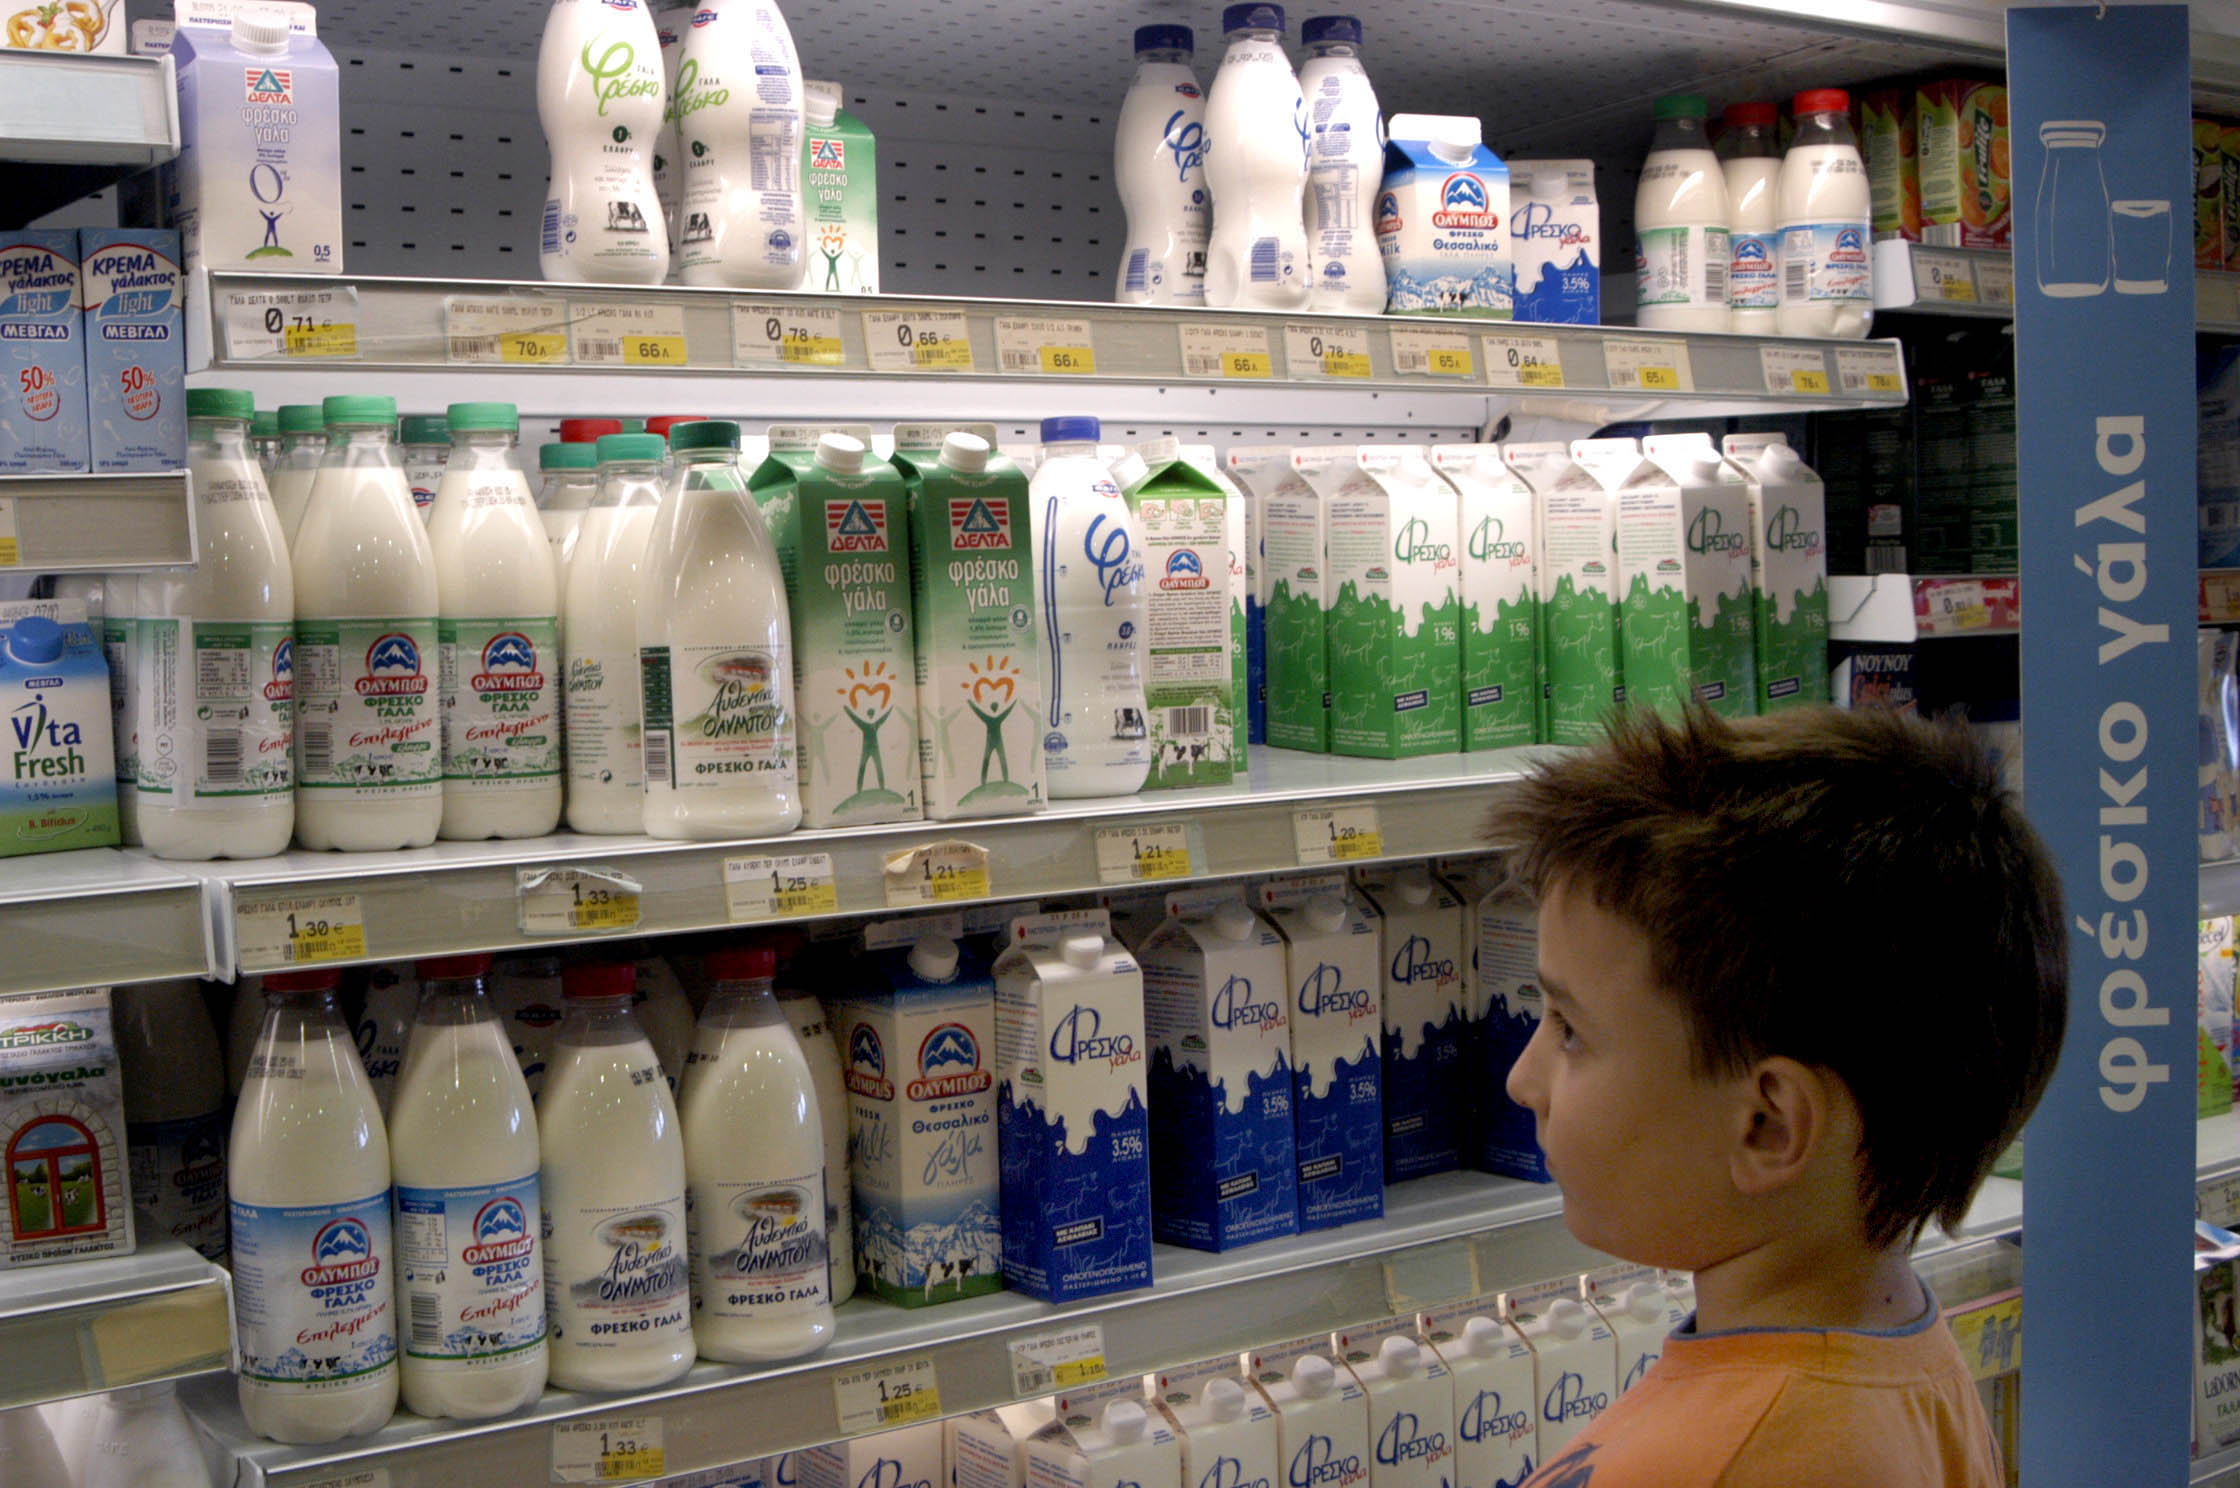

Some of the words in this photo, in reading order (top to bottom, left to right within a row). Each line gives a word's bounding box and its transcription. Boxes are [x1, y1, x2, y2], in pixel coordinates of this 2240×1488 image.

[248, 93, 291, 104] ΔΕΛΤΑ
[242, 106, 297, 128] φρέσκο
[255, 126, 289, 144] γάλα
[812, 157, 843, 169] ΔΕΛΤΑ
[1434, 212, 1497, 228] ΟΛΥΜΠΟΣ
[1433, 236, 1499, 252] Θεσσαλικό
[1449, 230, 1483, 238] ΦΡΕΣΚΟ
[93, 252, 155, 277] ΚΡΕΜΑ
[9, 271, 74, 294] γάλακτος
[112, 271, 174, 294] γάλακτος
[16, 294, 52, 314] light
[118, 294, 153, 314] light
[5, 327, 66, 338] ΜΕΒΓΑΛ
[107, 327, 165, 339] ΜΕΒΓΑΛ
[20, 366, 55, 392] 50%
[121, 366, 155, 393] 50%
[831, 534, 886, 551] ΔΕΛΤΑ
[954, 533, 1010, 548] ΔΕΛΤΑ
[2073, 415, 2170, 665] γάλα
[824, 558, 894, 589] φρέσκο
[948, 556, 1018, 585] φρέσκο
[1161, 579, 1208, 588] ΟΛΥΜΠΟΣ
[843, 587, 886, 618] γάλα
[966, 584, 1009, 614] γάλα
[358, 678, 425, 693] ΟΛΥΜΠΟΣ
[474, 676, 542, 689] ΟΛΥΜΠΟΣ
[364, 696, 423, 707] ΦΡΕΣΚΟ
[480, 692, 539, 702] ΦΡΕΣΚΟ
[492, 702, 530, 712] ΓΑΛΑ
[377, 707, 415, 717] ΓΑΛΑ
[11, 694, 82, 754] Vita
[15, 748, 84, 779] Fresh
[695, 761, 753, 775] ΦΡΕΣΚΟ
[908, 790, 914, 806] 1
[1032, 782, 1039, 798] 1
[771, 870, 807, 893] 1,25
[571, 883, 609, 907] 1,33
[2076, 701, 2170, 1112] φρέσκο
[287, 913, 329, 940] 1,30
[1298, 961, 1369, 1017] ΦΡΕΣΚΟ
[1212, 974, 1279, 1031] ΦΡΕΣΚΟ
[0, 1029, 87, 1048] ΤΡΙΚΚΗ
[1050, 1004, 1133, 1065] ΦΡΕΣΚΟ
[1108, 1045, 1142, 1075] γάλα
[910, 1073, 988, 1100] ΟΛΥΜΠΟΣ
[929, 1099, 975, 1113] ΦΡΕΣΚΟ
[912, 1112, 990, 1134] Θεσσαλικό
[1112, 1137, 1143, 1157] 3.5%
[466, 1239, 533, 1263] ΟΛΥΜΠΟΣ
[736, 1241, 812, 1273] ΟΛΥΜΠΟΥ
[304, 1261, 377, 1283] ΟΛΥΜΠΟΣ
[472, 1257, 530, 1277] ΦΡΕΣΚΟ
[311, 1280, 375, 1298] ΦΡΕΣΚΟ
[485, 1272, 523, 1286] ΓΑΛΑ
[600, 1265, 676, 1301] ΟΛΥΜΠΟΥ
[325, 1293, 366, 1309] ΓΑΛΑ
[728, 1292, 785, 1306] ΦΡΕΣΚΟ
[790, 1286, 819, 1301] ΓΑΛΑ
[591, 1319, 650, 1335] ΦΡΕΣΚΟ
[654, 1312, 682, 1328] ΓΑΛΑ
[1543, 1370, 1608, 1425] ΦΡΕΣΚΟ
[1460, 1390, 1527, 1444] ΦΡΕΣΚΟ
[1376, 1411, 1446, 1467] ΦΡΕΣΚΟ
[1289, 1433, 1360, 1488] ΦΡΕΣΚΟ
